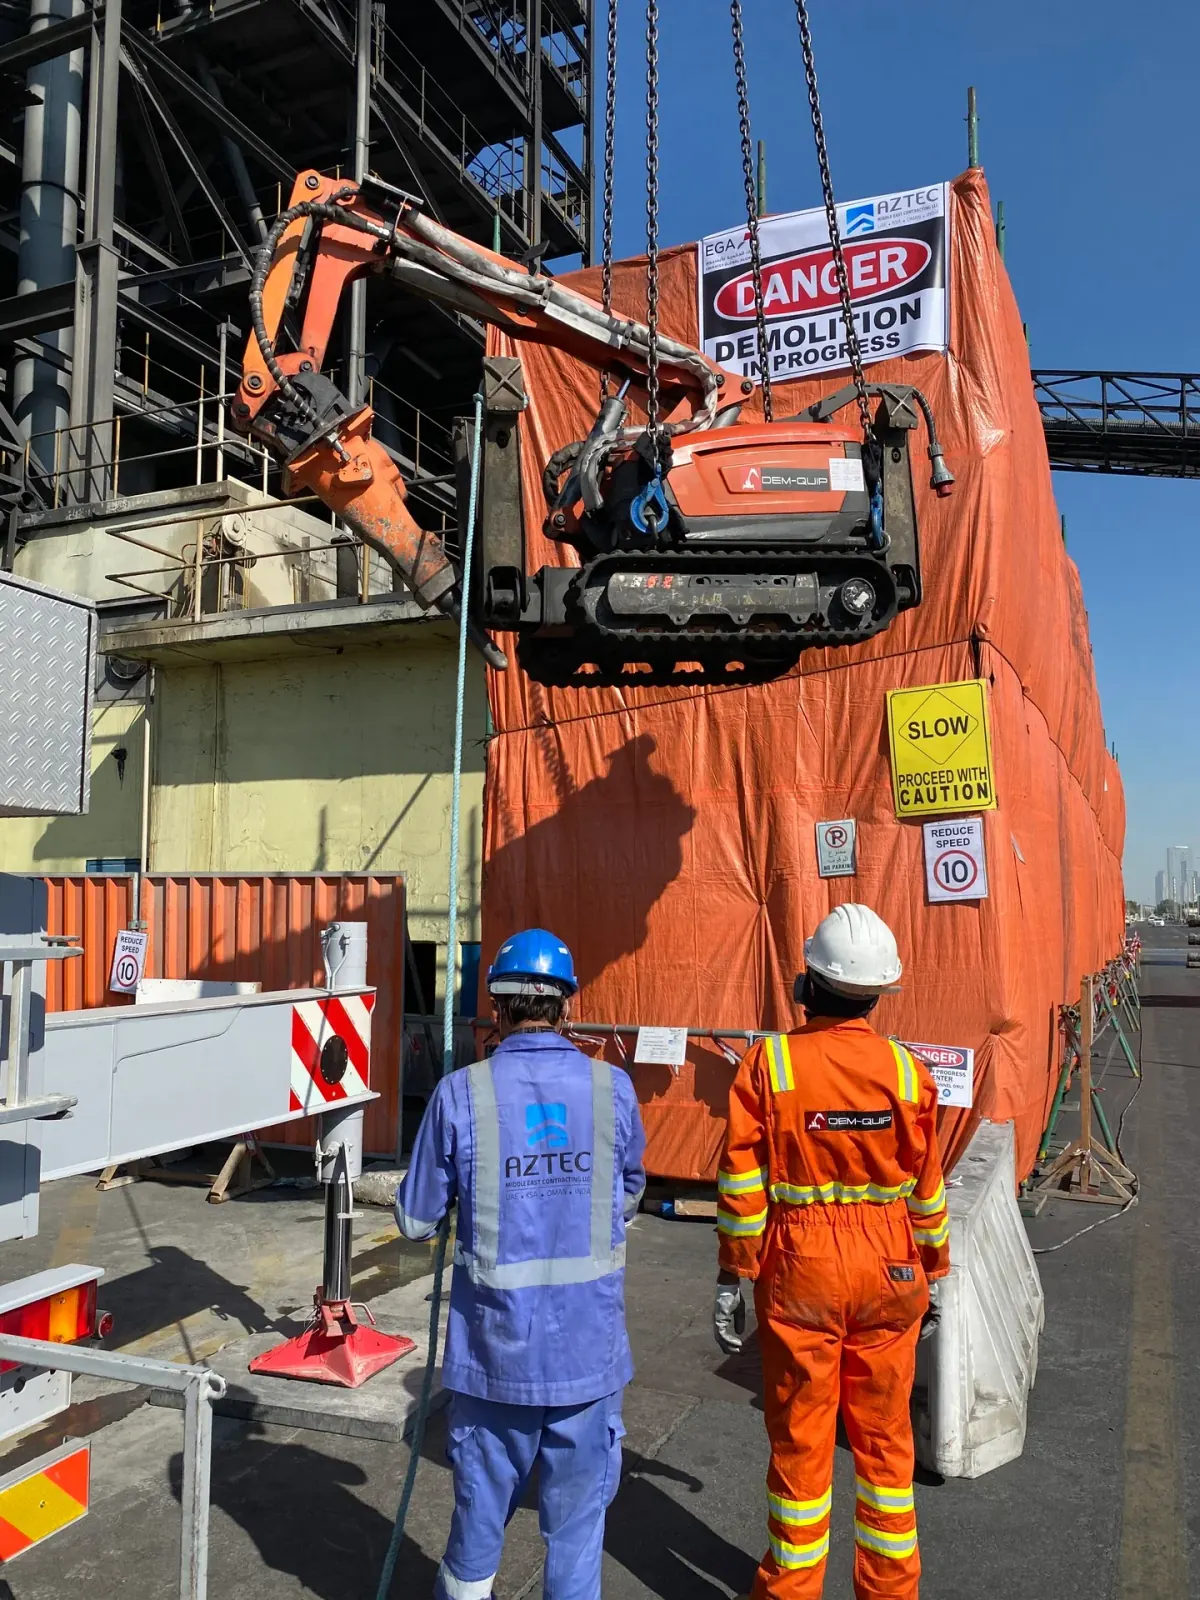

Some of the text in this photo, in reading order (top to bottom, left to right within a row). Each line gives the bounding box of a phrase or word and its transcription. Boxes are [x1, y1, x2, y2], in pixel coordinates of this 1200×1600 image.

[877, 188, 939, 214] AZTEC
[706, 238, 735, 256] EGA
[736, 246, 908, 314] DANGER
[743, 332, 900, 377] IN PROGRESS
[762, 476, 828, 486] DEM-QUIP
[908, 716, 969, 740] SLOW
[899, 767, 987, 788] PROCEED WITH
[900, 783, 989, 805] CAUTION
[931, 826, 974, 837] REDUCE
[936, 838, 970, 848] SPEED
[942, 860, 968, 883] 10
[120, 936, 143, 946] REDUCE
[121, 945, 139, 954] SPEED
[120, 962, 134, 981] 10
[828, 1116, 892, 1126] DEM-QUIP
[505, 1151, 591, 1178] AZTEC
[542, 1177, 581, 1185] CONTRACTING
[547, 1188, 567, 1196] OMAN
